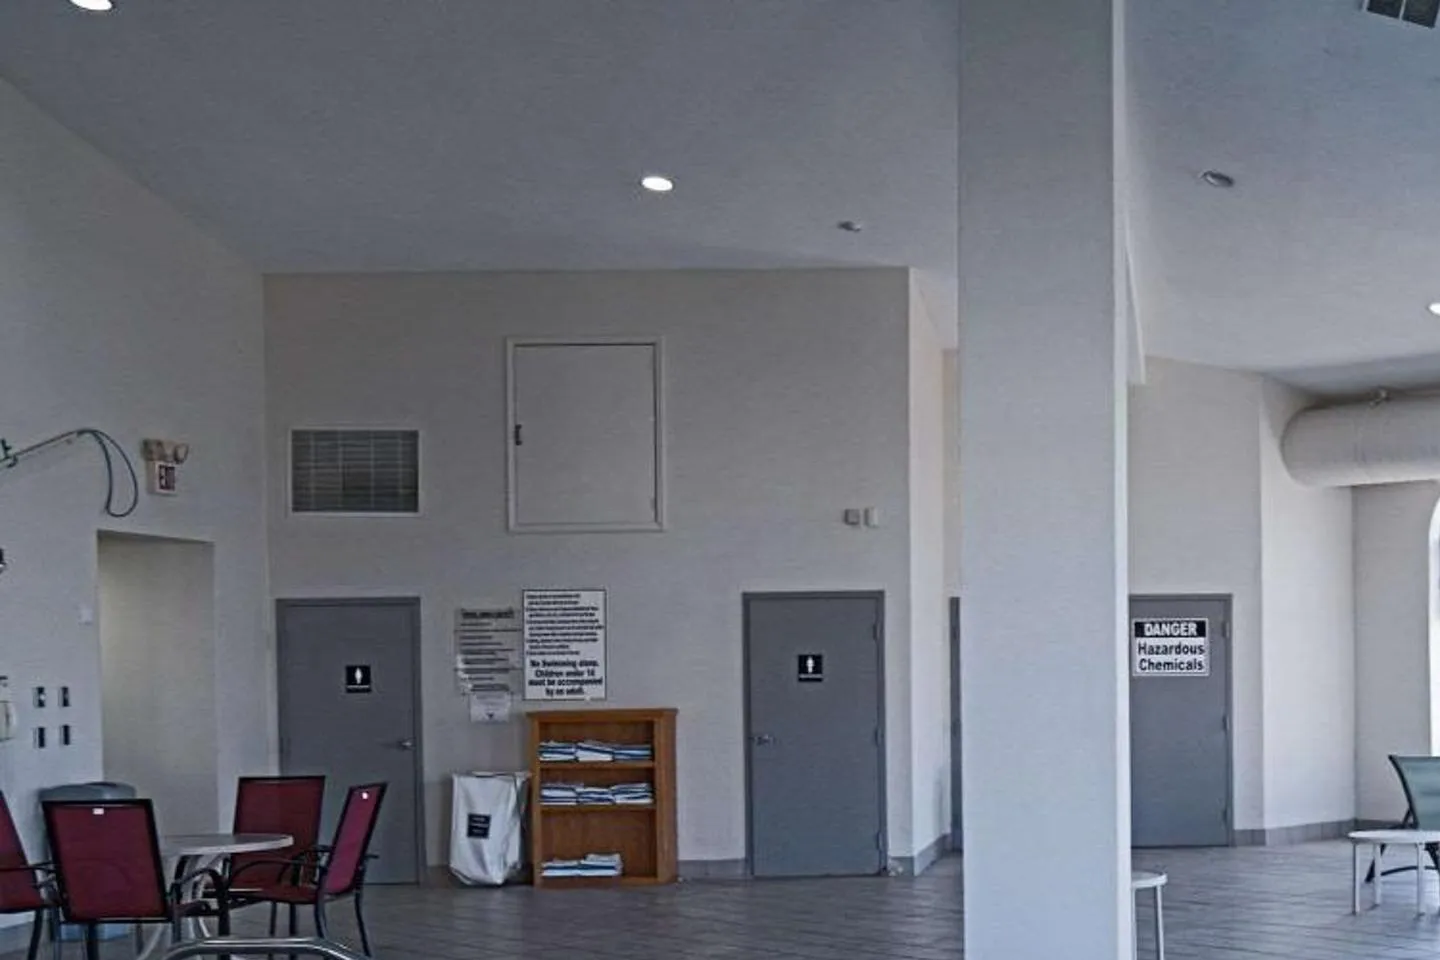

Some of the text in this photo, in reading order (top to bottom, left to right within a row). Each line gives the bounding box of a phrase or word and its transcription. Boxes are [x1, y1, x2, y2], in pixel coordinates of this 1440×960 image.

[1144, 623, 1198, 636] DANGER
[1138, 641, 1205, 655] Hazardous
[1139, 658, 1204, 671] Chemicals
